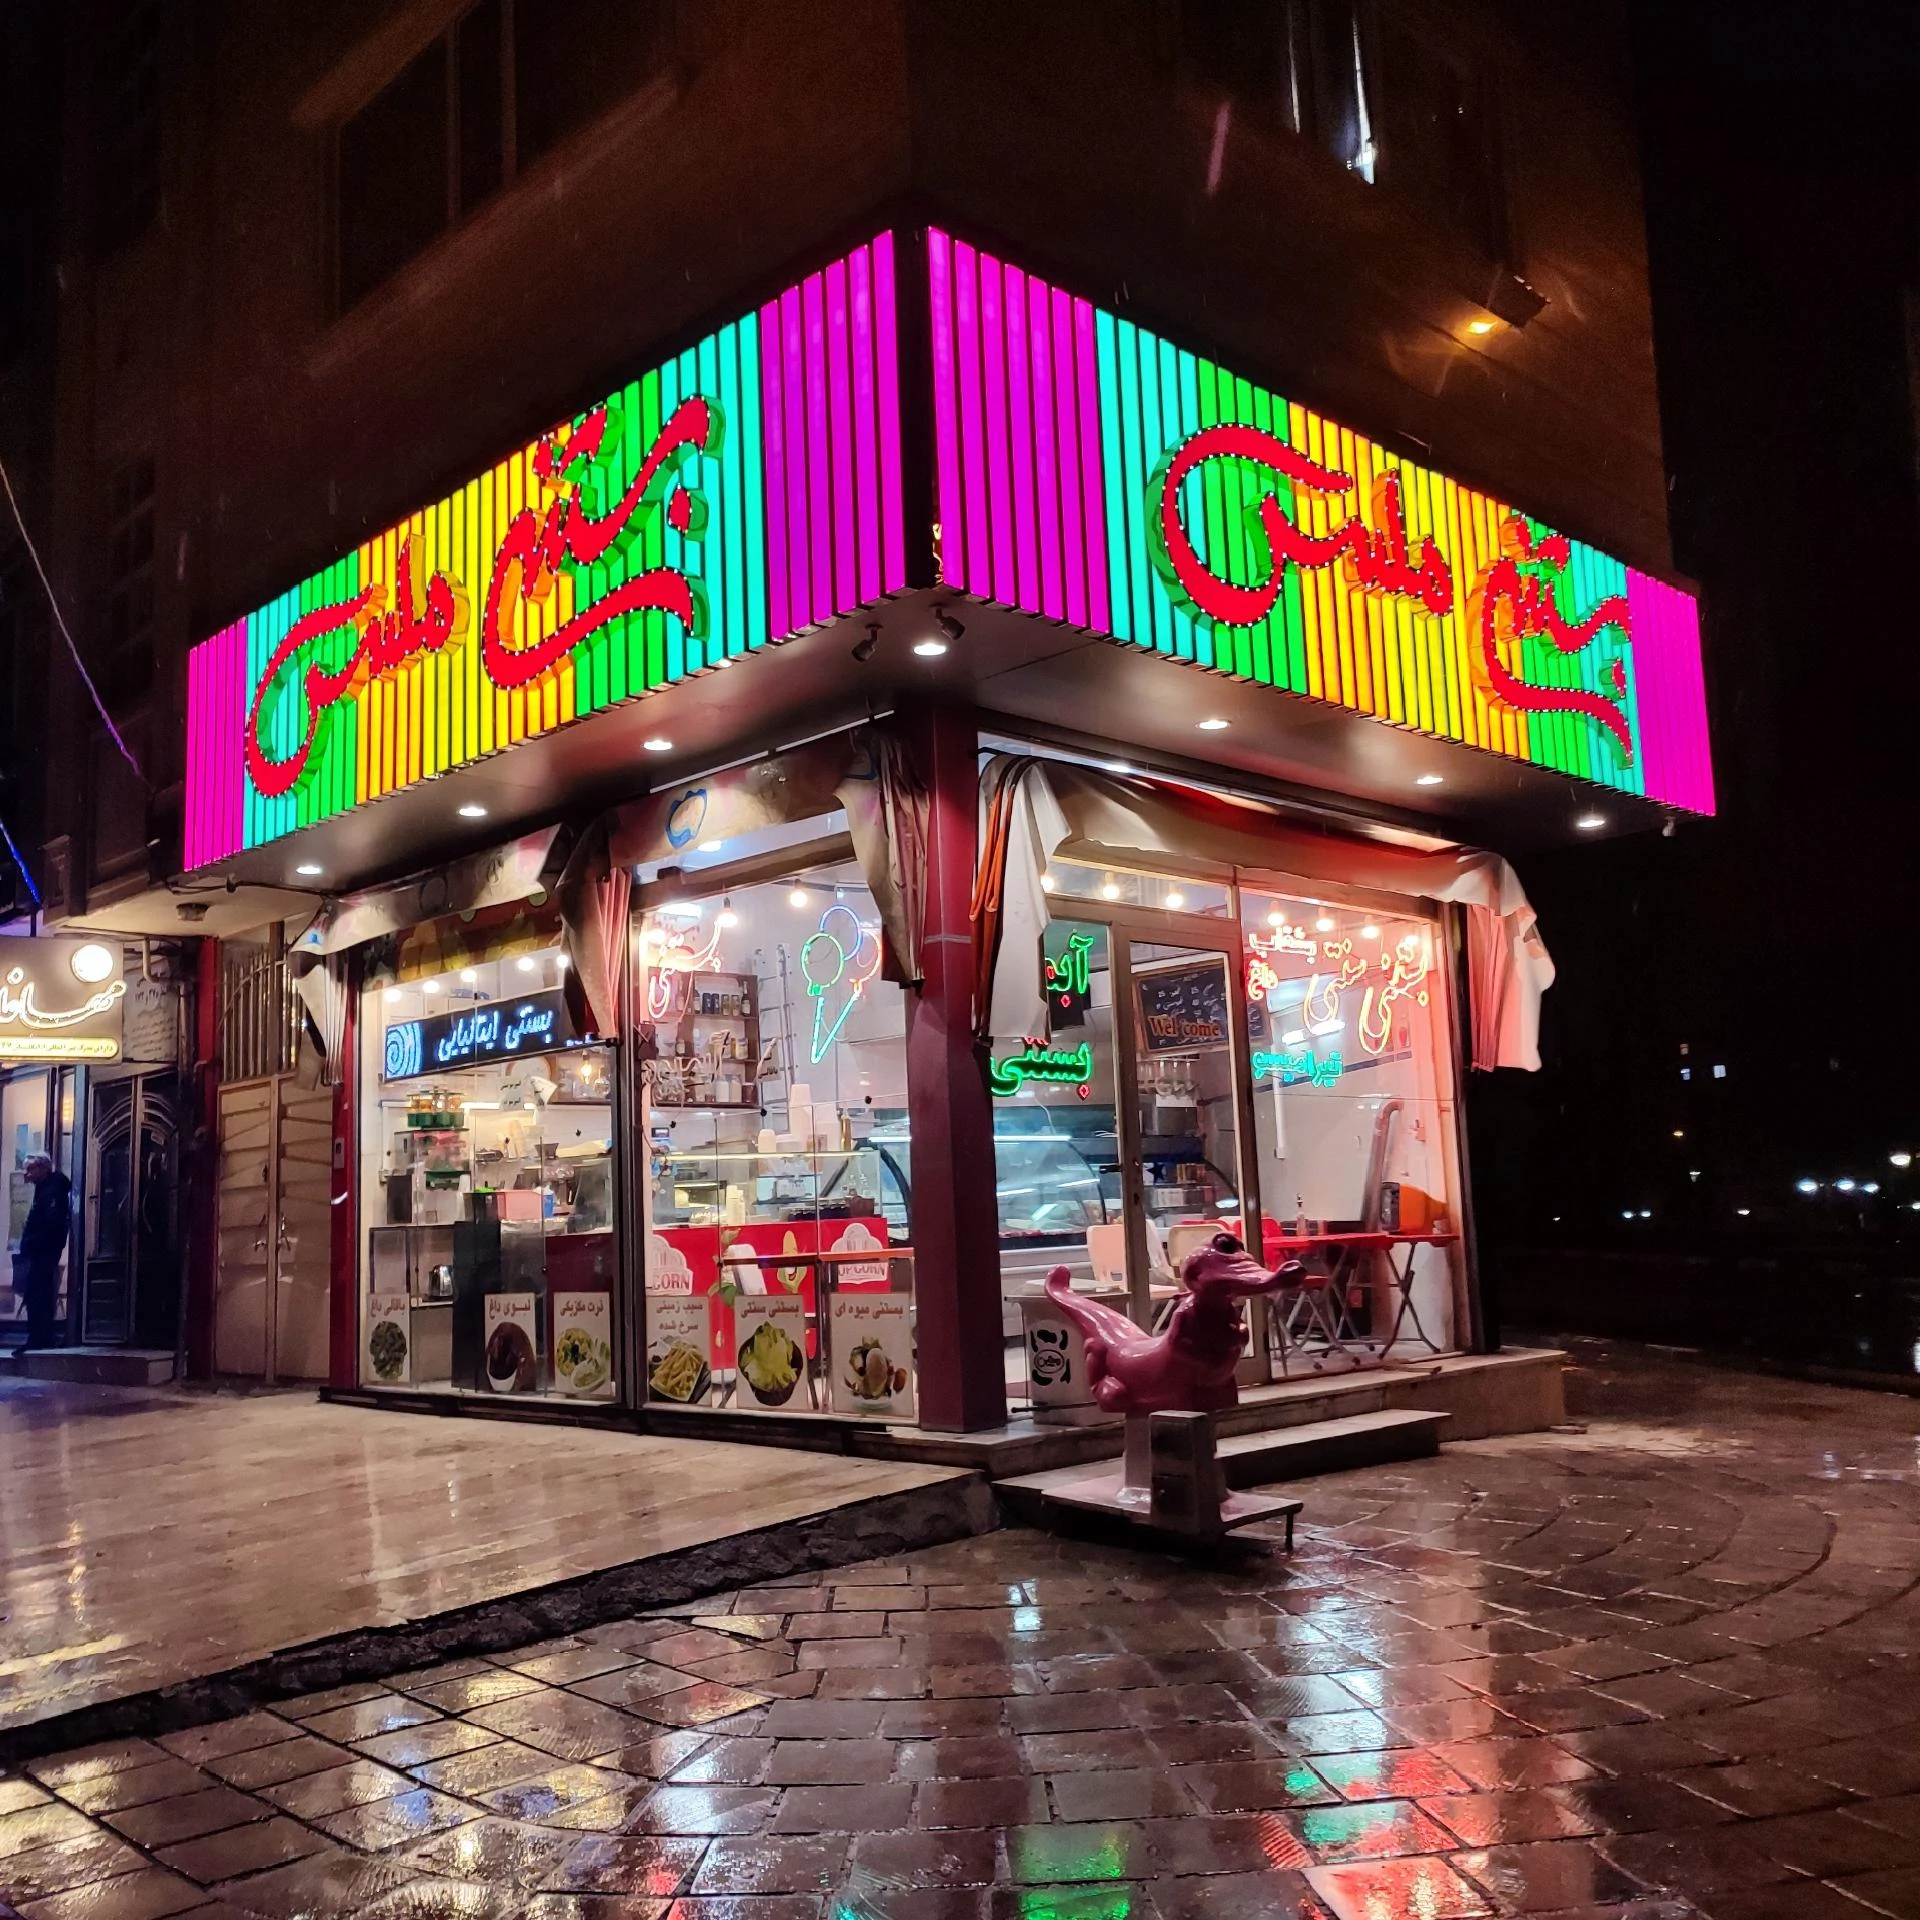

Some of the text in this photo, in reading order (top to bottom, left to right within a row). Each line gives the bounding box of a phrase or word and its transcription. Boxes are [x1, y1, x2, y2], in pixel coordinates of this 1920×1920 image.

[483, 396, 713, 690] بستنی
[1481, 513, 1634, 769] بستنی
[506, 1004, 553, 1050] بستنی
[990, 1036, 1092, 1099] بستنی
[656, 1300, 703, 1315] سیب زمینی
[741, 1301, 799, 1318] بستنی سنتی
[872, 1302, 904, 1319] بستنی
[659, 1318, 699, 1335] سرخ شده
